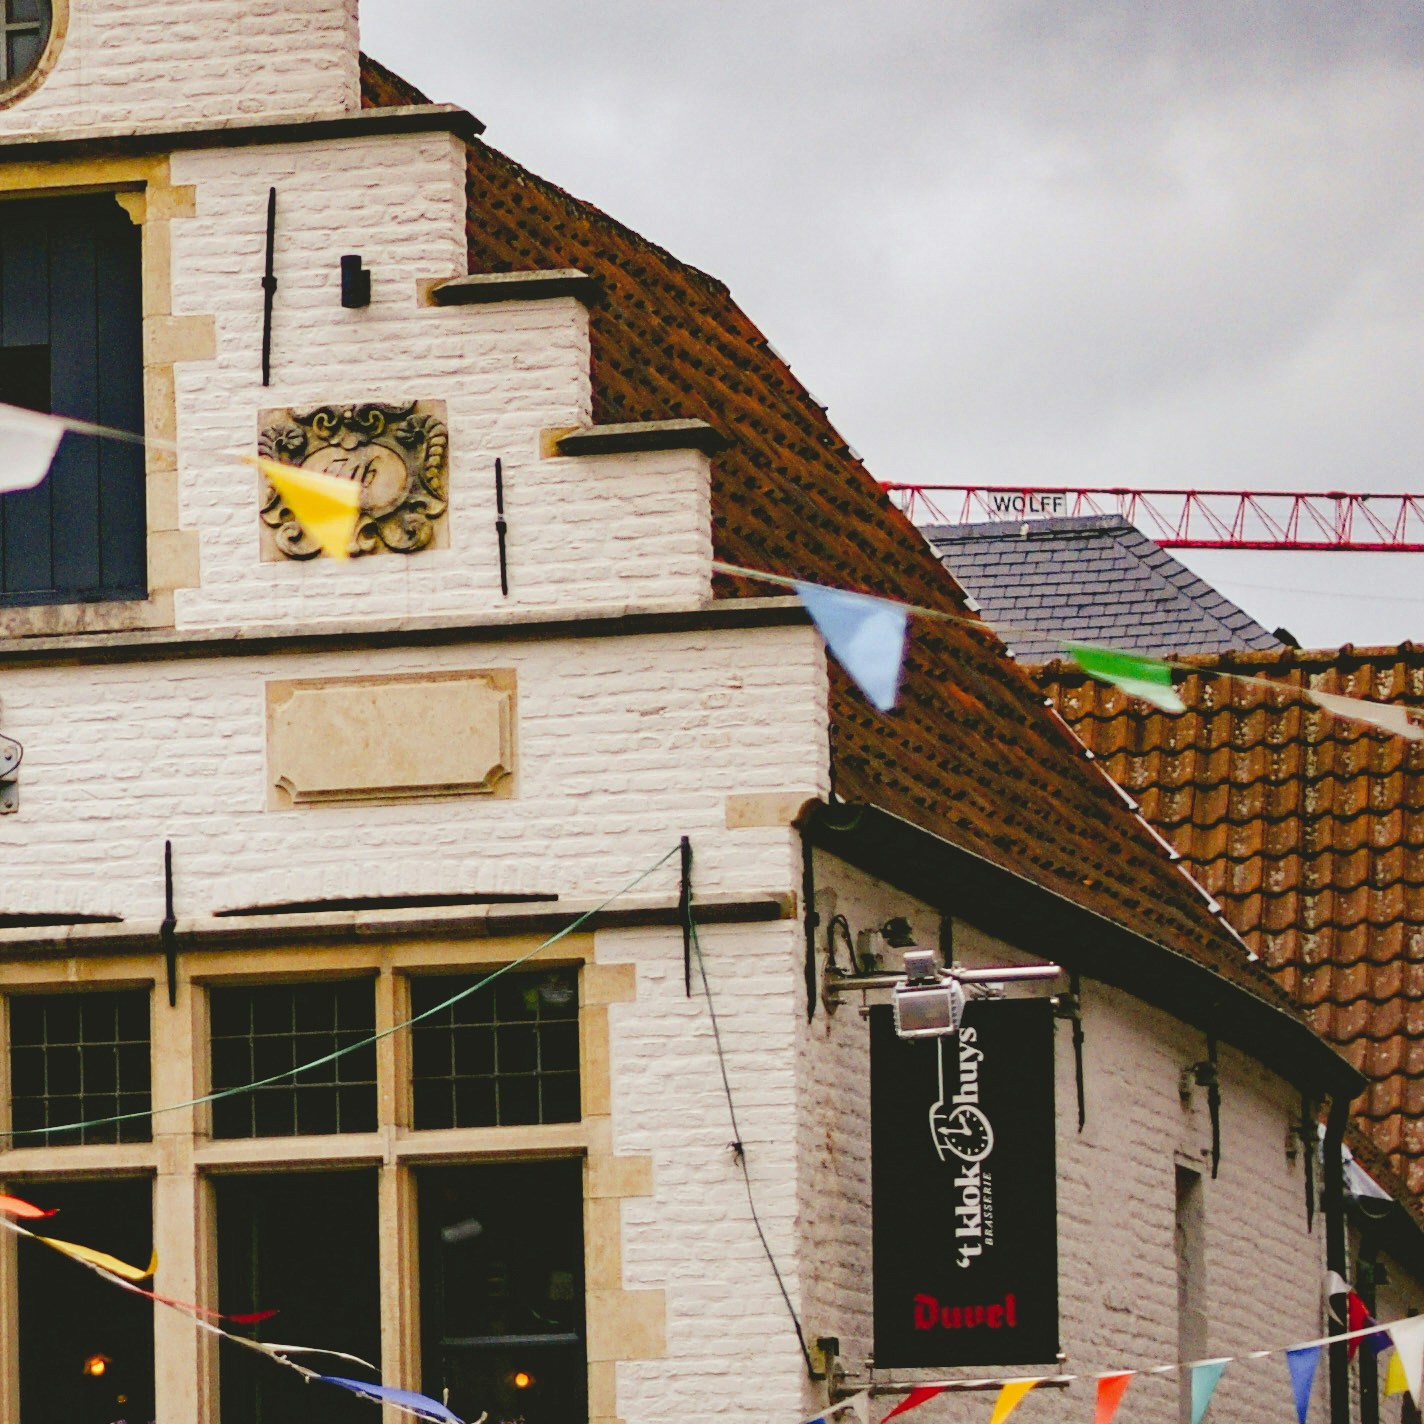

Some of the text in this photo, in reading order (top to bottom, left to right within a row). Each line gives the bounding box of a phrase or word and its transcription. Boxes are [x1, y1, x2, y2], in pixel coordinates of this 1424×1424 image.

[993, 495, 1064, 513] WOLFF
[982, 1171, 994, 1247] BRASSERIE
[913, 1292, 1017, 1331] Duvel
